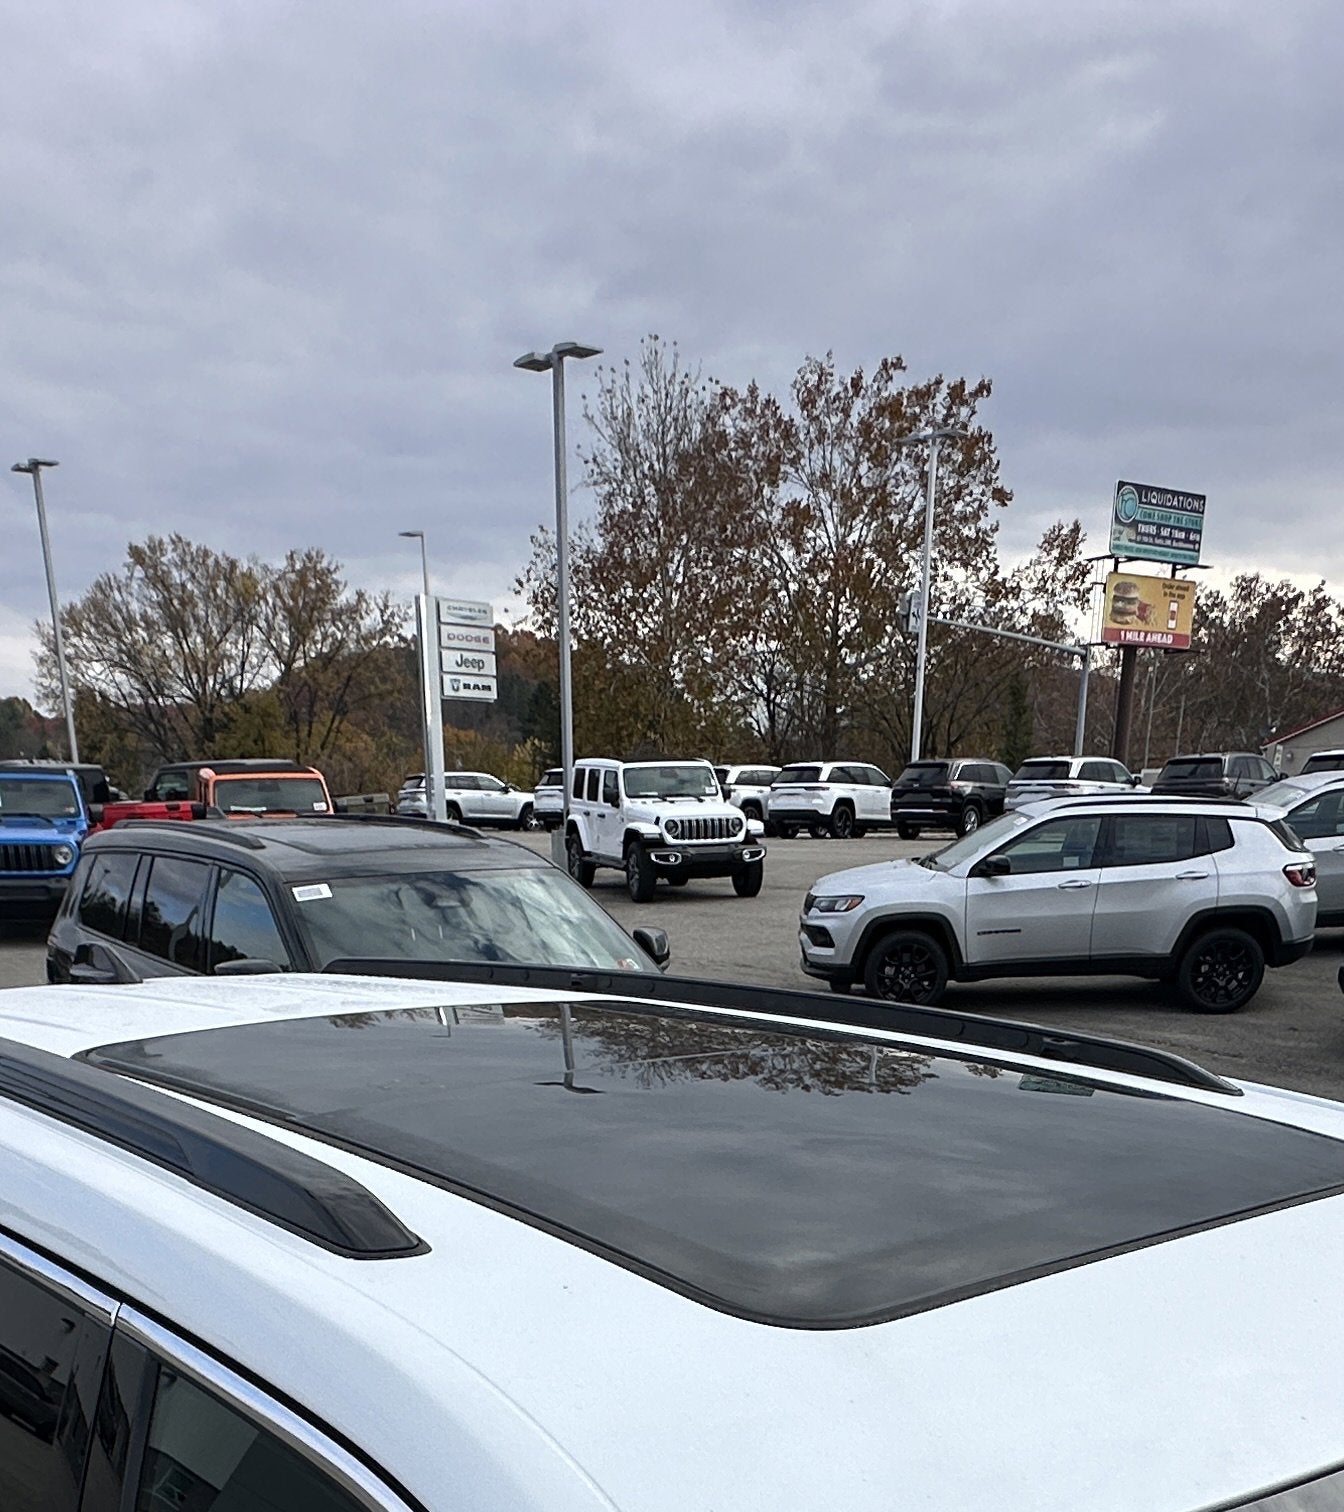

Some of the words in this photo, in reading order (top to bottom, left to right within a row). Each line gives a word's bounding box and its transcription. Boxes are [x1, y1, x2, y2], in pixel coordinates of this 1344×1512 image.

[1141, 490, 1204, 512] LIQUIDATIONS
[447, 632, 490, 644] DODGE
[1120, 630, 1125, 640] 1
[1126, 631, 1145, 642] MILE
[1146, 633, 1173, 644] AHEAD
[455, 653, 485, 671] Jeep
[463, 682, 492, 691] RAM
